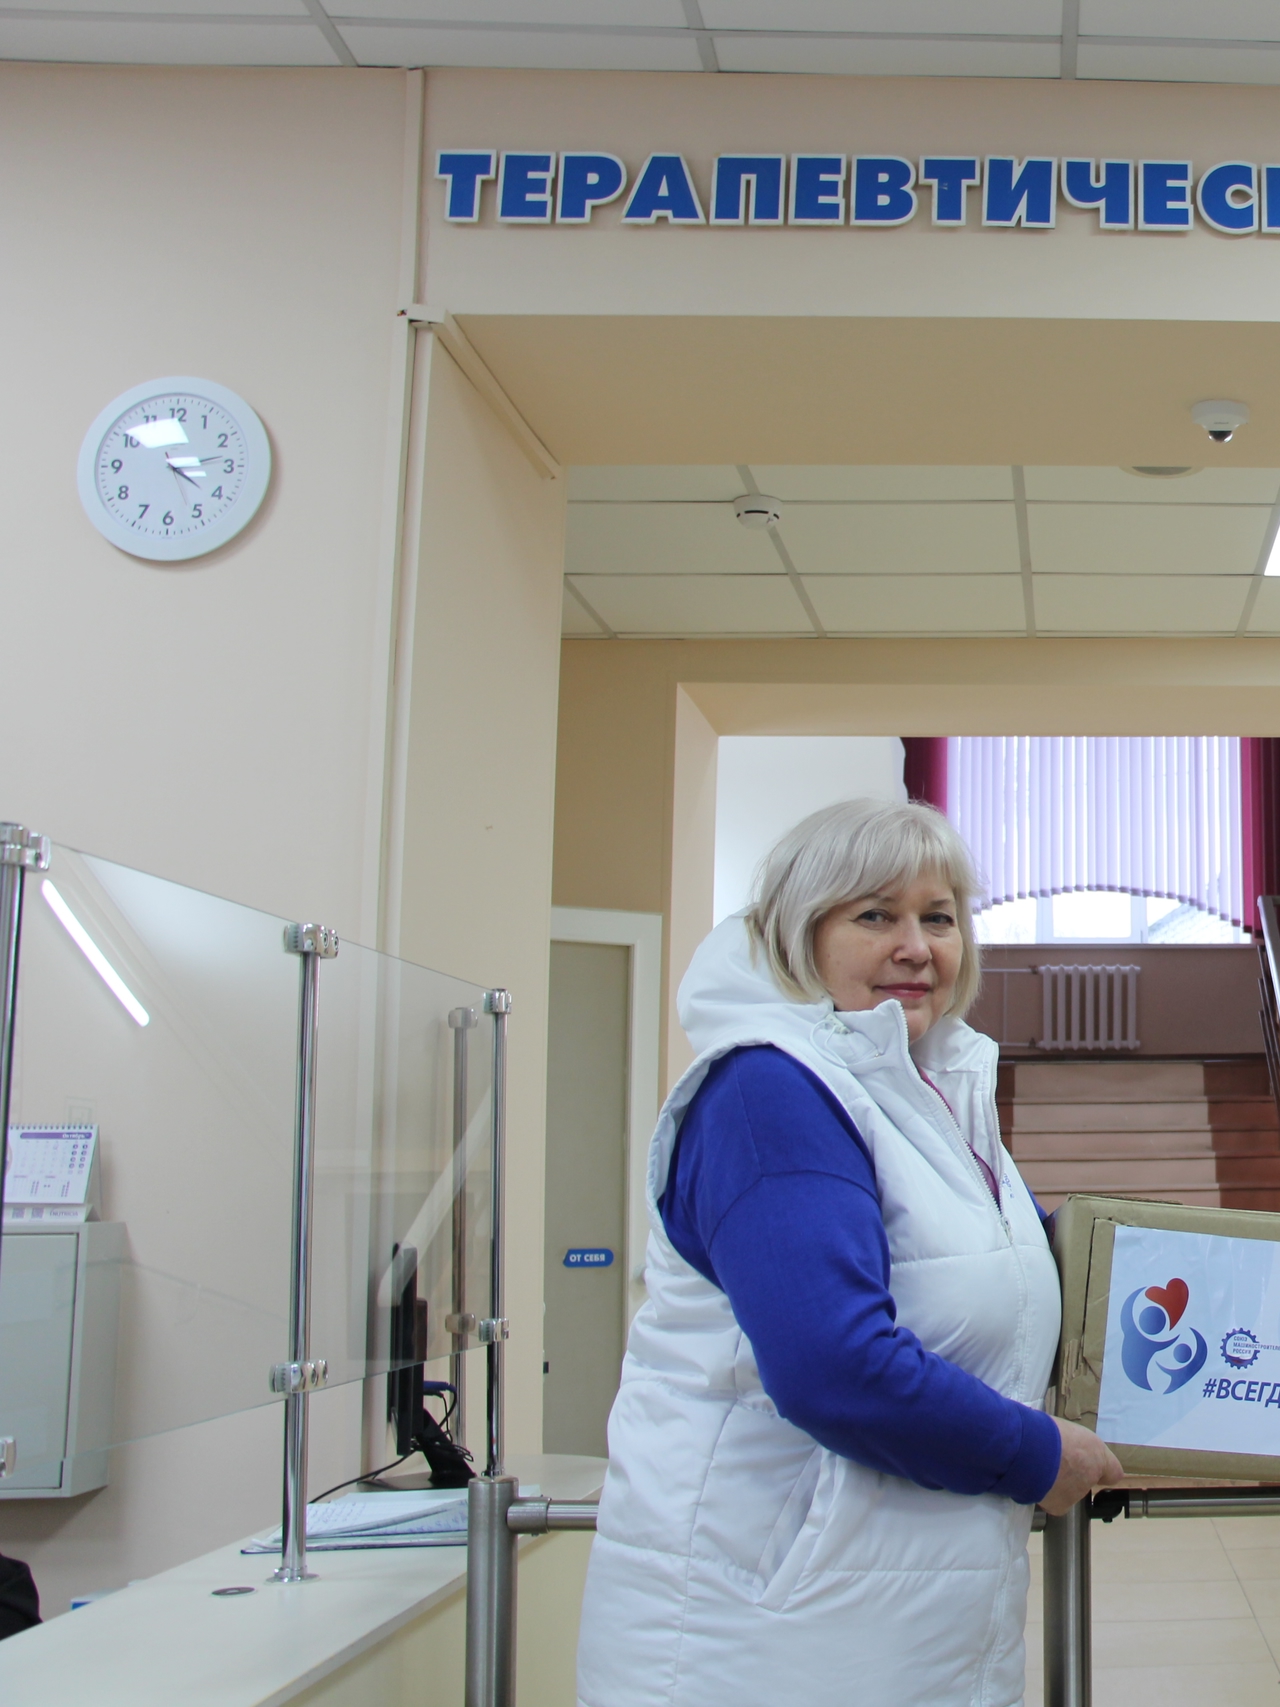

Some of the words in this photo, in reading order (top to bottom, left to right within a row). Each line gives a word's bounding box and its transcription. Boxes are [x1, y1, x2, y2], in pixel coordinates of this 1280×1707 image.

[169, 408, 187, 422] 12
[201, 415, 208, 429] 1
[123, 433, 140, 448] 10
[217, 433, 229, 448] 2
[111, 459, 123, 474] 9
[223, 459, 235, 474] 3
[118, 485, 129, 500] 8
[211, 486, 223, 500] 4
[138, 504, 150, 519] 7
[162, 511, 174, 526] 6
[191, 504, 202, 518] 5
[569, 1254, 581, 1262] ОТ
[584, 1253, 605, 1262] СЕБЯ
